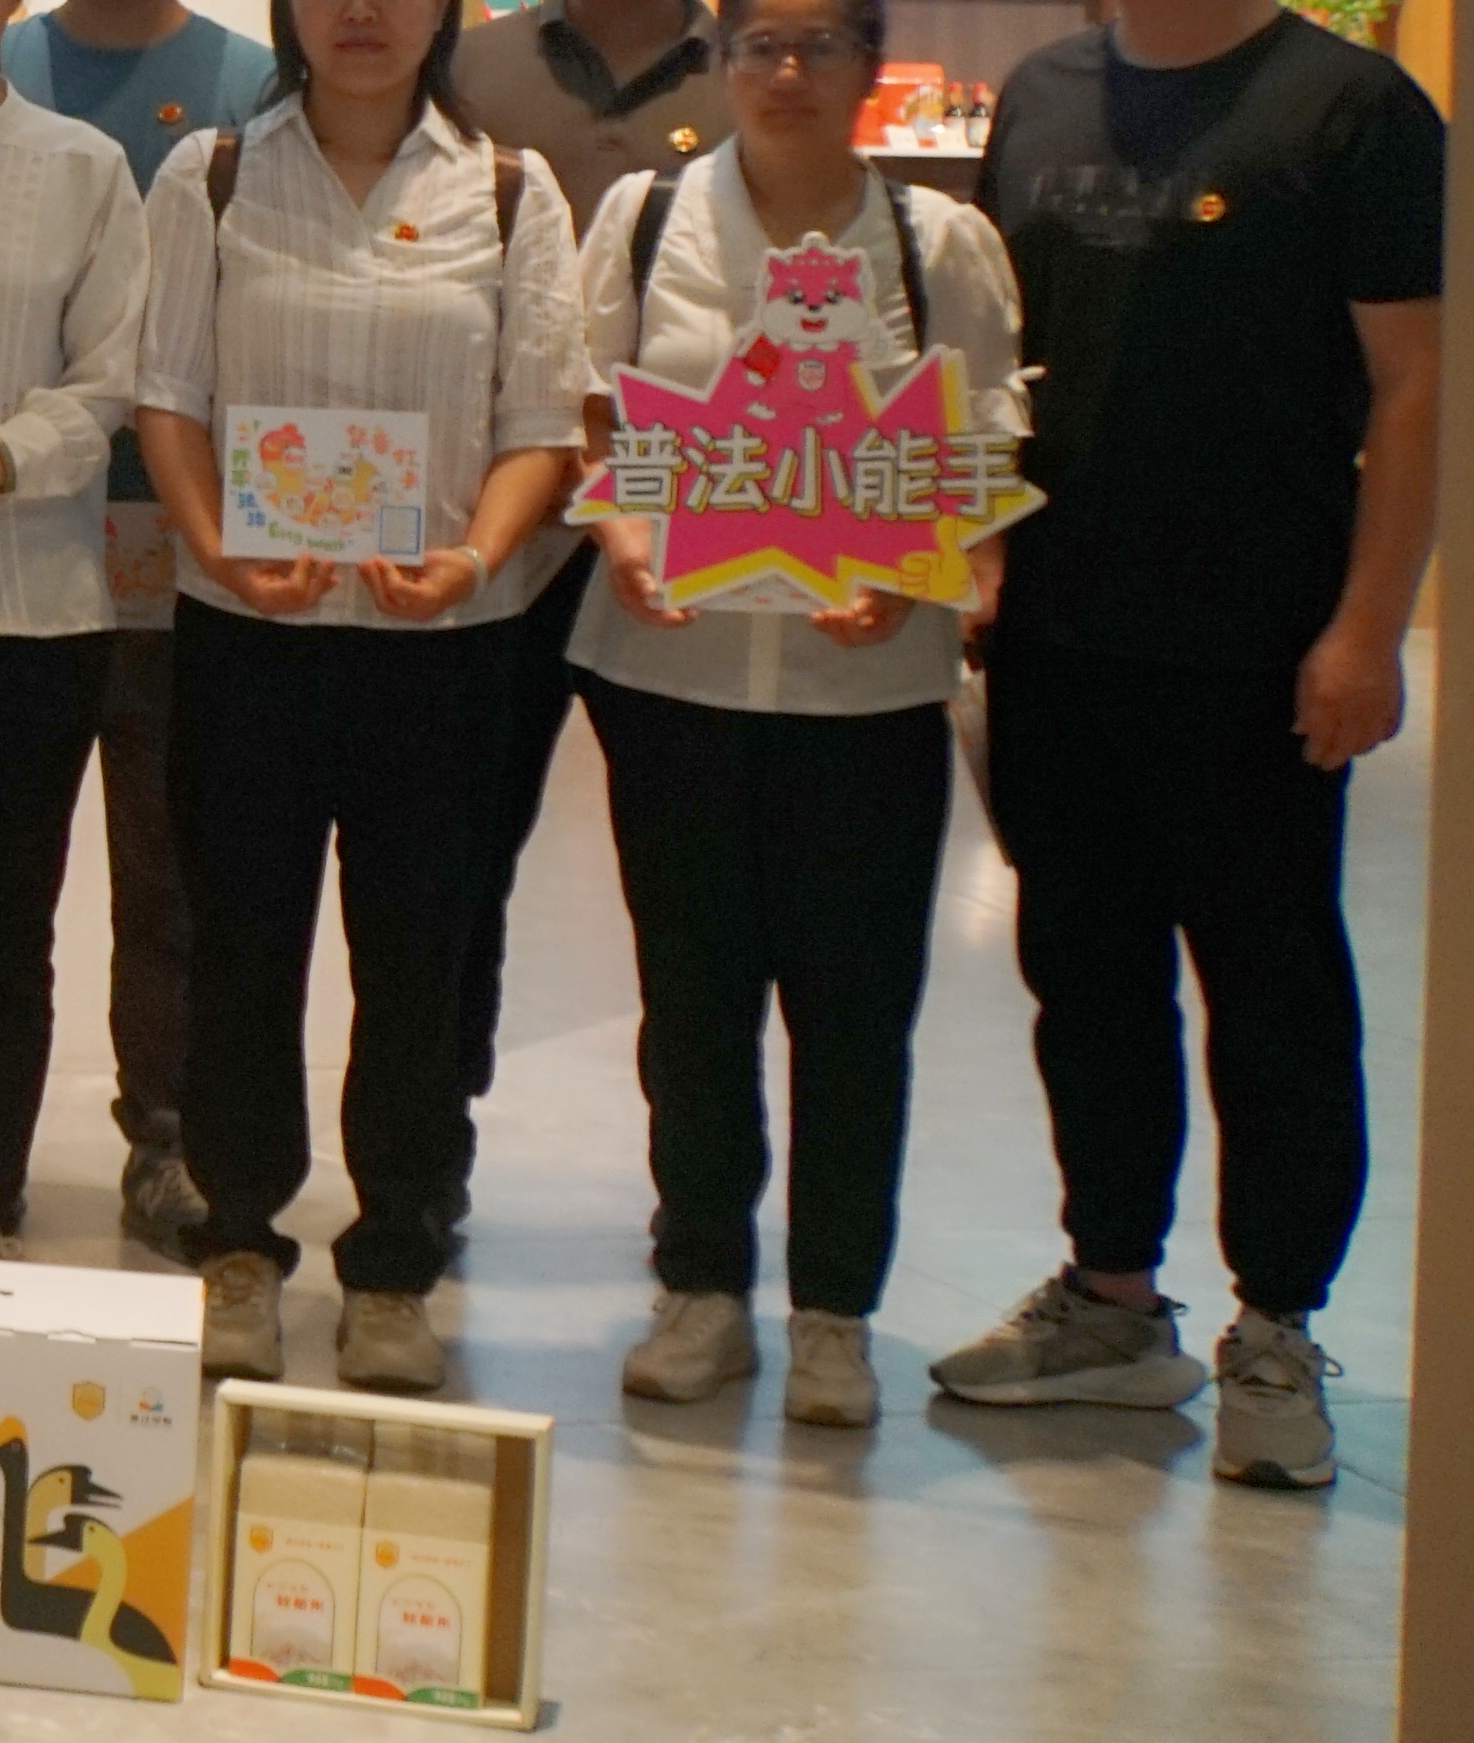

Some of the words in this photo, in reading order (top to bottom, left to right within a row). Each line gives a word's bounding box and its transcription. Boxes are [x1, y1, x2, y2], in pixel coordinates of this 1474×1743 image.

[604, 421, 1032, 524] 普法小能手
